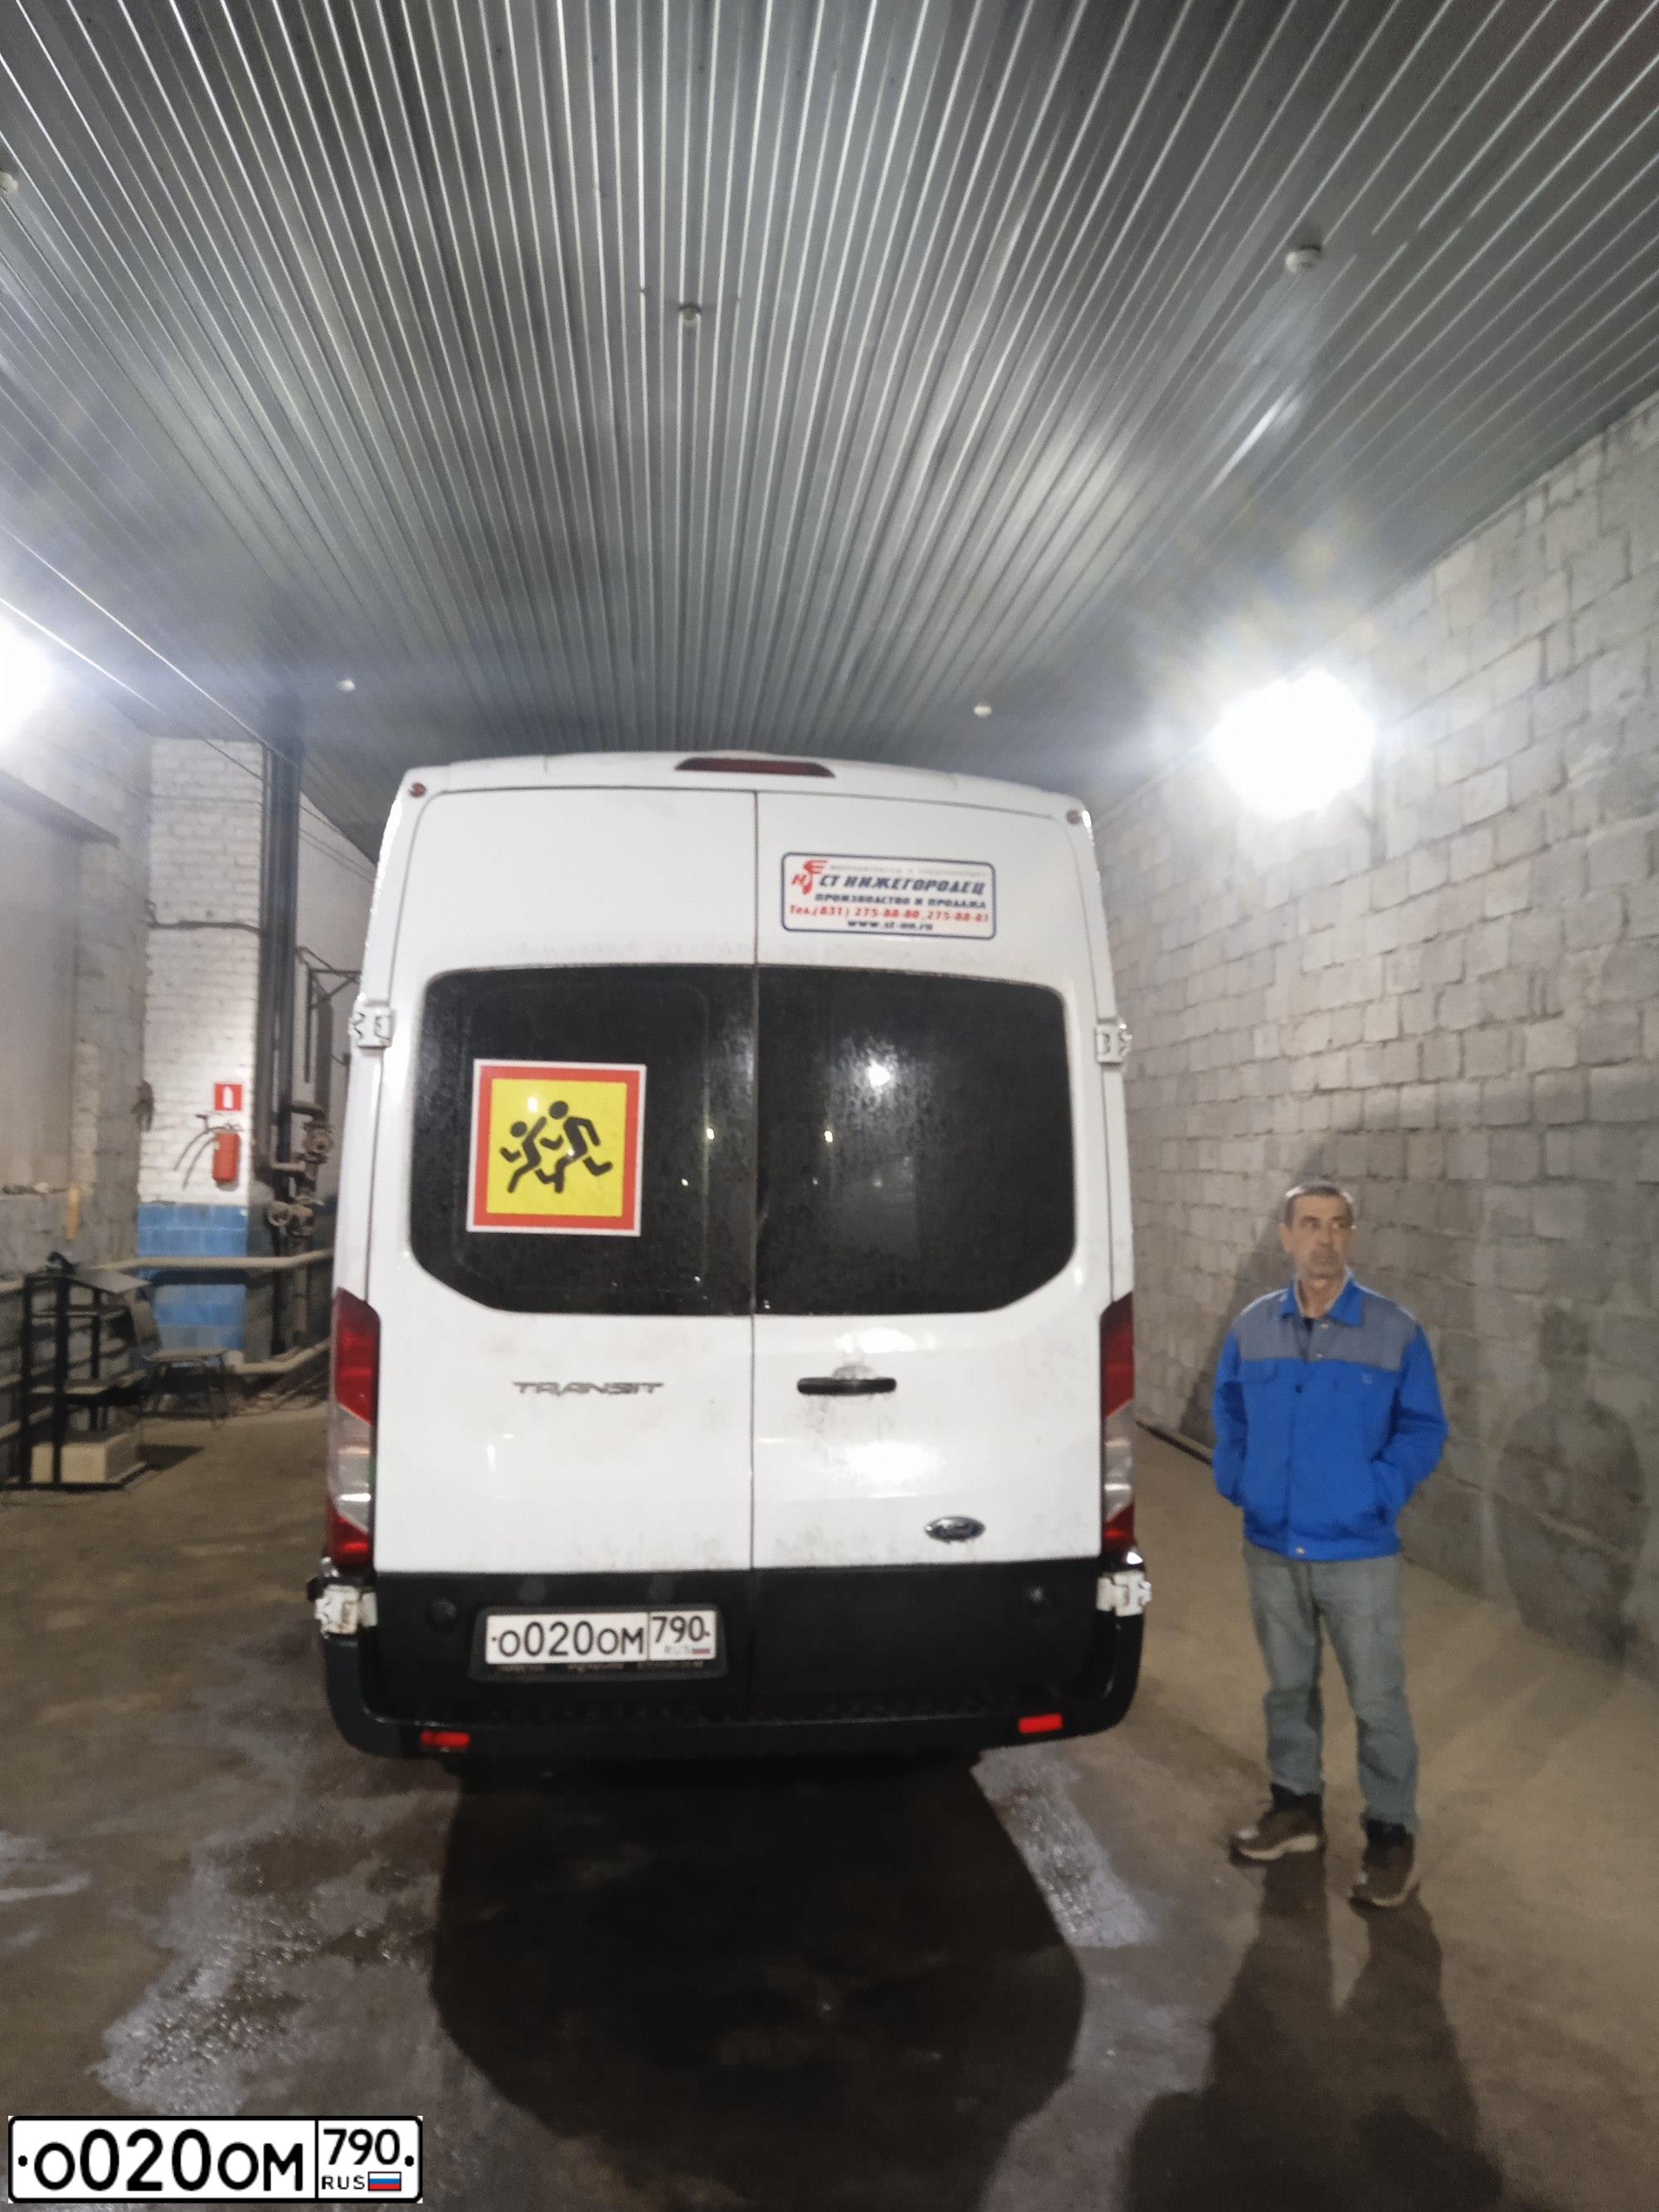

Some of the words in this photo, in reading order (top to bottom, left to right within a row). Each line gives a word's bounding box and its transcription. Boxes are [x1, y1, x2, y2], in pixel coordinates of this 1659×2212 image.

[819, 875, 840, 887] СТ
[843, 875, 985, 895] НИЖЕГОРОДЕЦ
[513, 1381, 664, 1396] TRANSIT
[651, 1615, 706, 1643] 790
